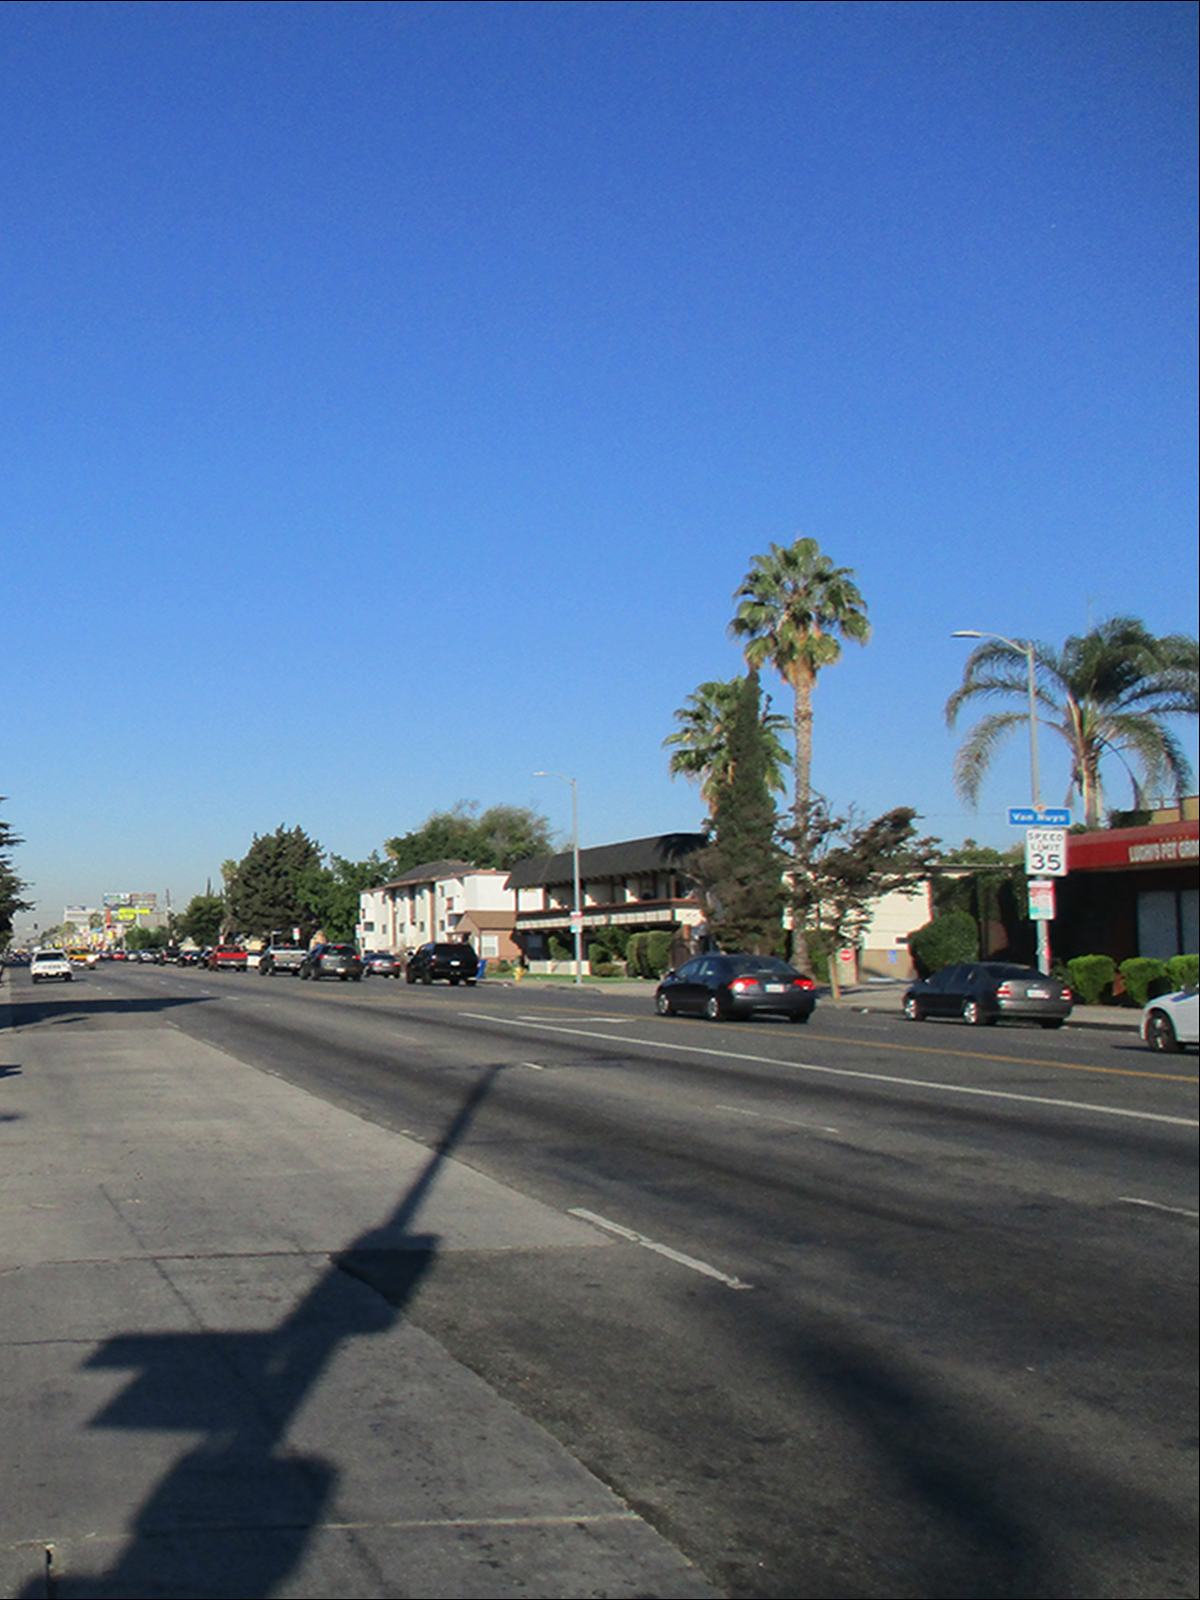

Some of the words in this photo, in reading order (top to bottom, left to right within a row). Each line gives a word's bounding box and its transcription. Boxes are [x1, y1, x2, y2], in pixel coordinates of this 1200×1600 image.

[1012, 813, 1035, 821] Van
[1037, 813, 1067, 823] Nuys
[1028, 832, 1064, 841] SPEED
[1031, 853, 1062, 871] 35
